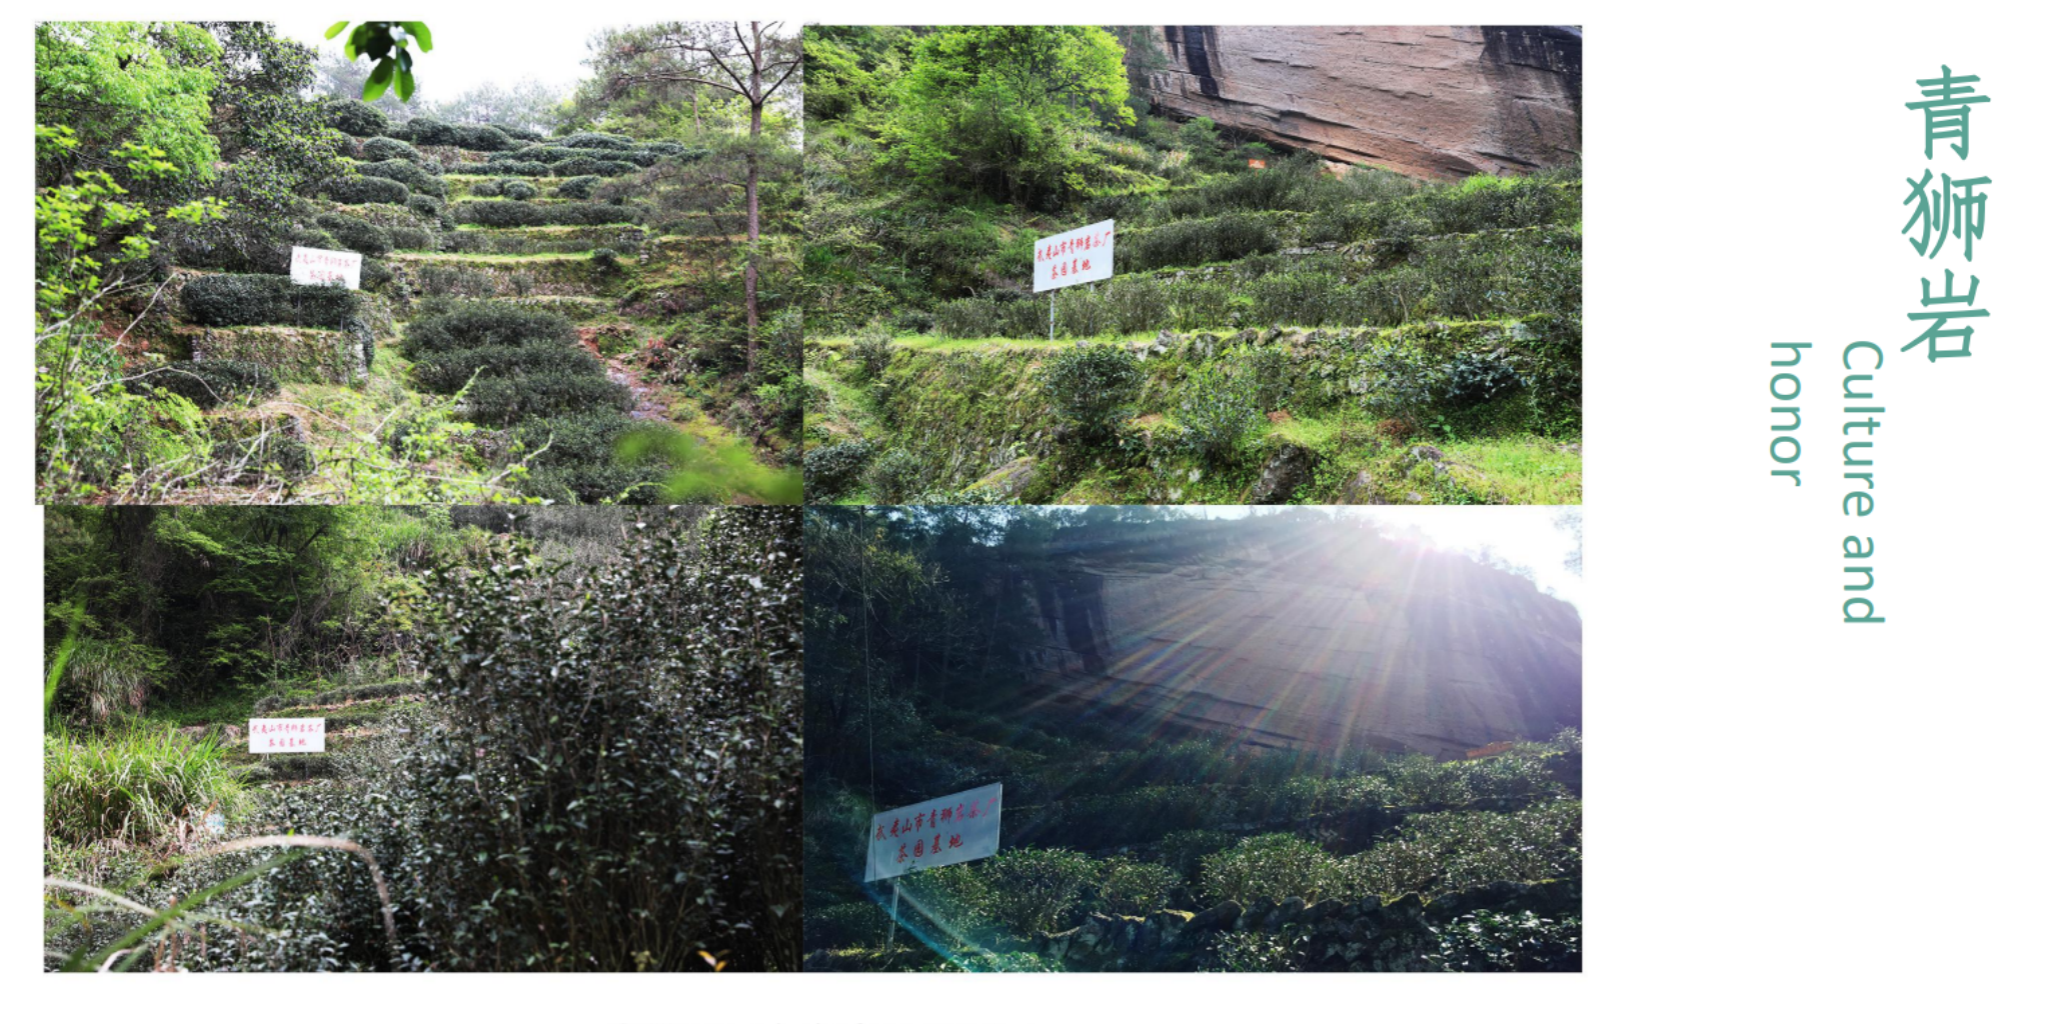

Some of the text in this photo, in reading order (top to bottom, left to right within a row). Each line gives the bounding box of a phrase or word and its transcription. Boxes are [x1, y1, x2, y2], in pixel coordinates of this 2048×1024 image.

[1051, 258, 1092, 280] 茶园基地
[875, 796, 998, 842] 武夷山市青狮岩茶厂
[896, 833, 964, 864] 茶园基地
